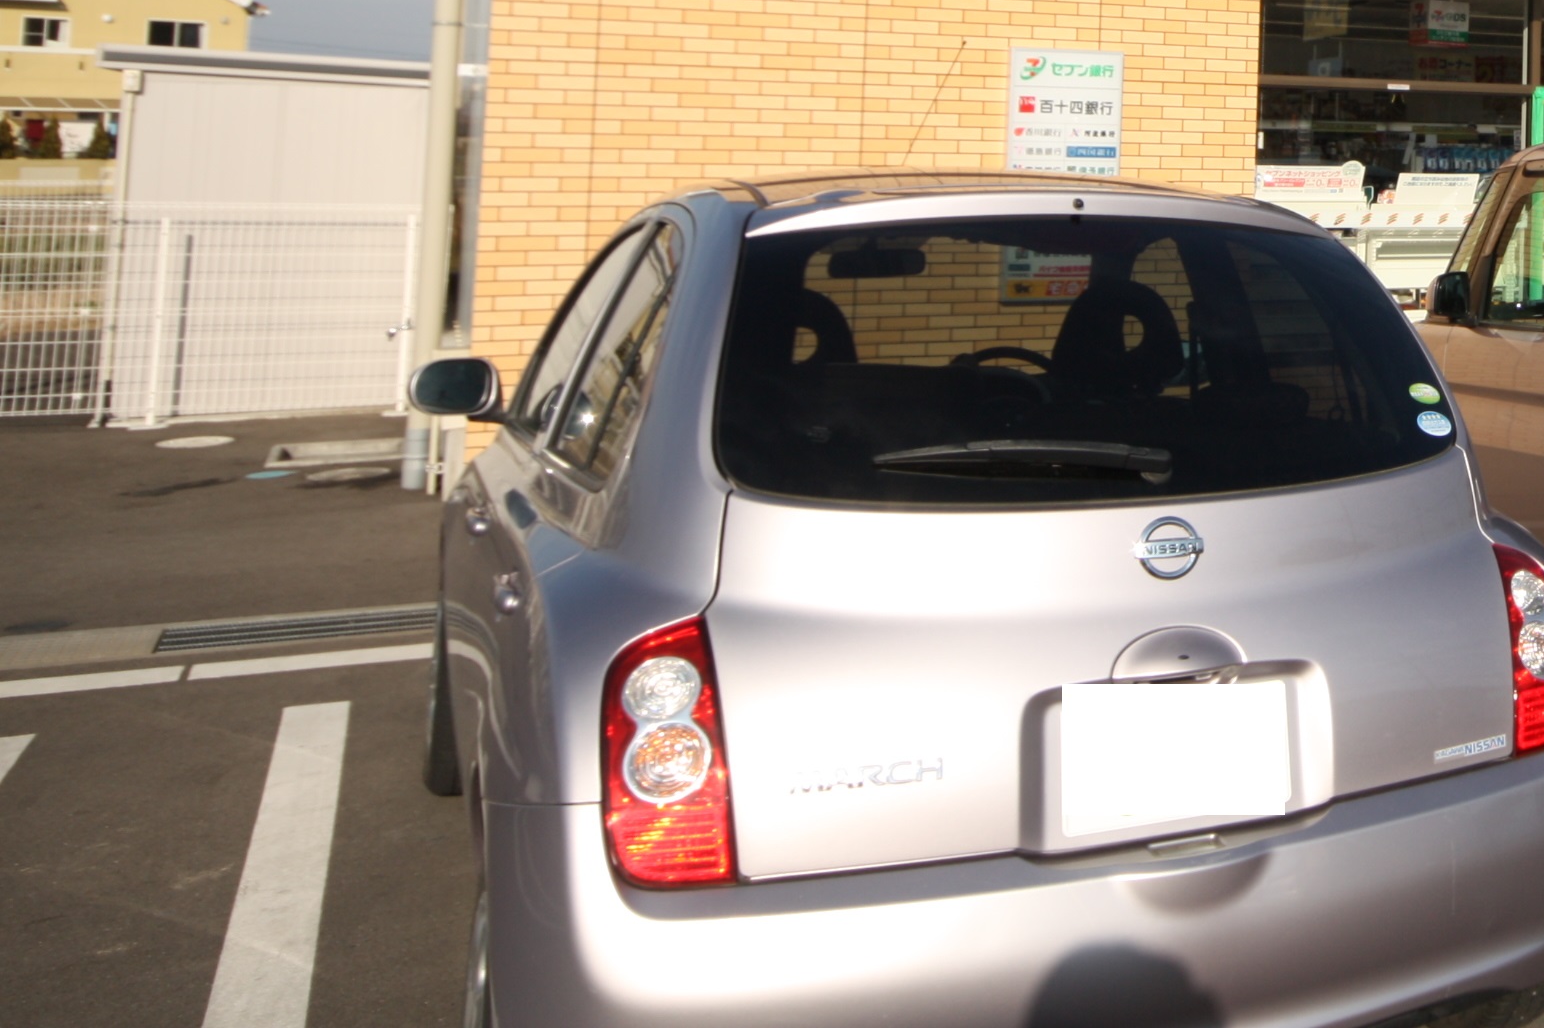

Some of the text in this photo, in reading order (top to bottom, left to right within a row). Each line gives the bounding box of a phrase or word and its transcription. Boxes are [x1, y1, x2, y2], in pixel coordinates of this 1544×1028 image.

[1051, 62, 1114, 78] セブン銀行
[1039, 99, 1114, 116] 百十四銀行
[1144, 542, 1200, 555] NISSAN
[1464, 735, 1505, 755] NISSAN
